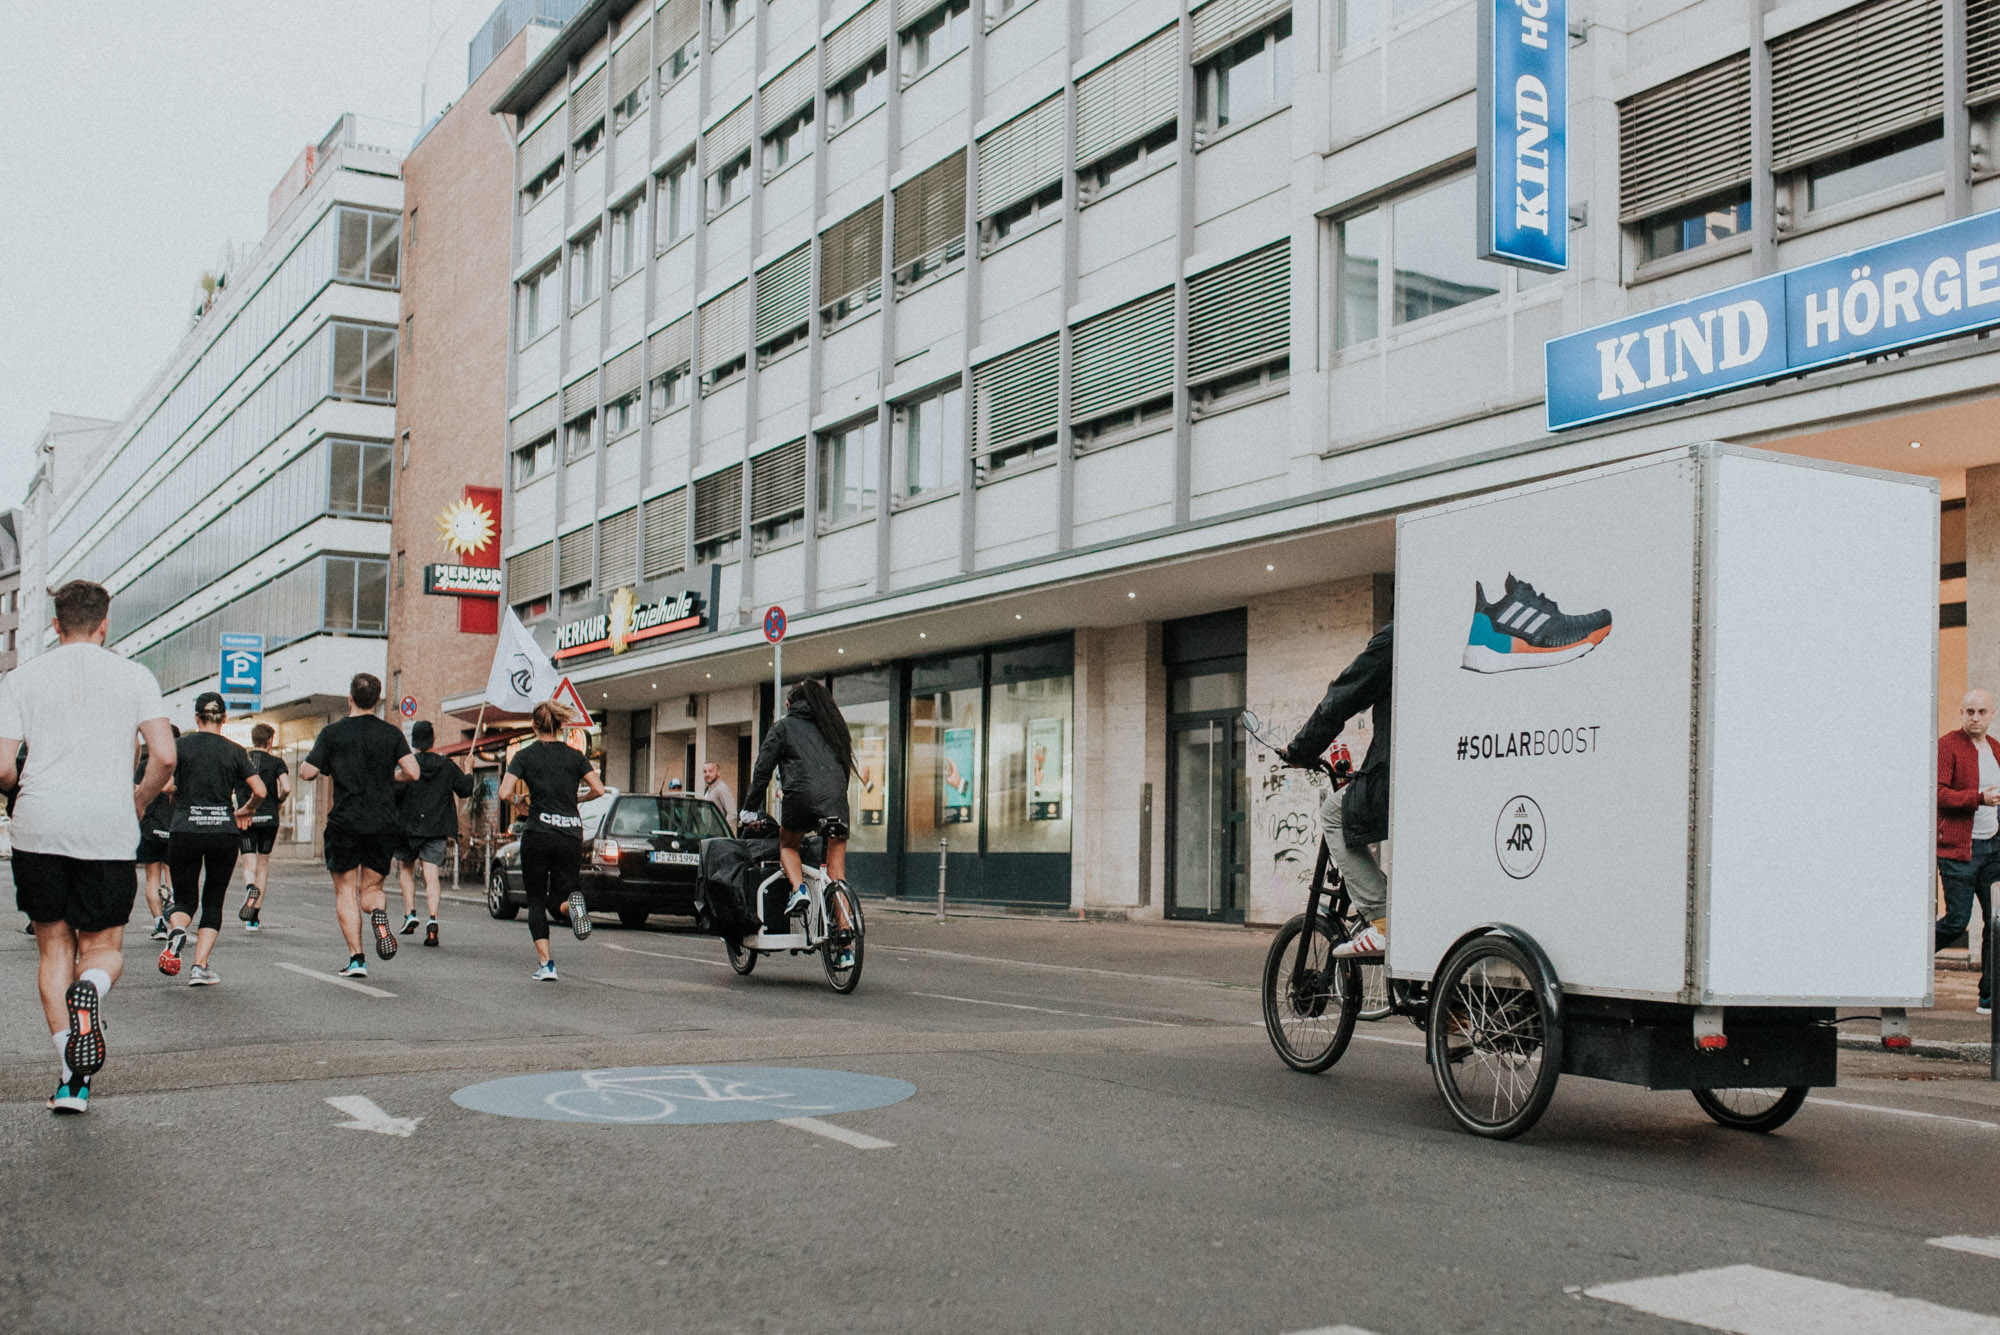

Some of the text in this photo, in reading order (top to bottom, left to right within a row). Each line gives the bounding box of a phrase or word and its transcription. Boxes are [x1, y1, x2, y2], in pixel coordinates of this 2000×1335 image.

[1515, 0, 1549, 236] KIND HÖ
[1596, 242, 2000, 401] KIND HÖRGE
[435, 564, 501, 584] MERKUR
[556, 591, 693, 650] MERKUR Spielhalle
[1457, 726, 1600, 760] #SOLARBOOST
[539, 812, 582, 828] CREW
[679, 854, 699, 863] 1994
